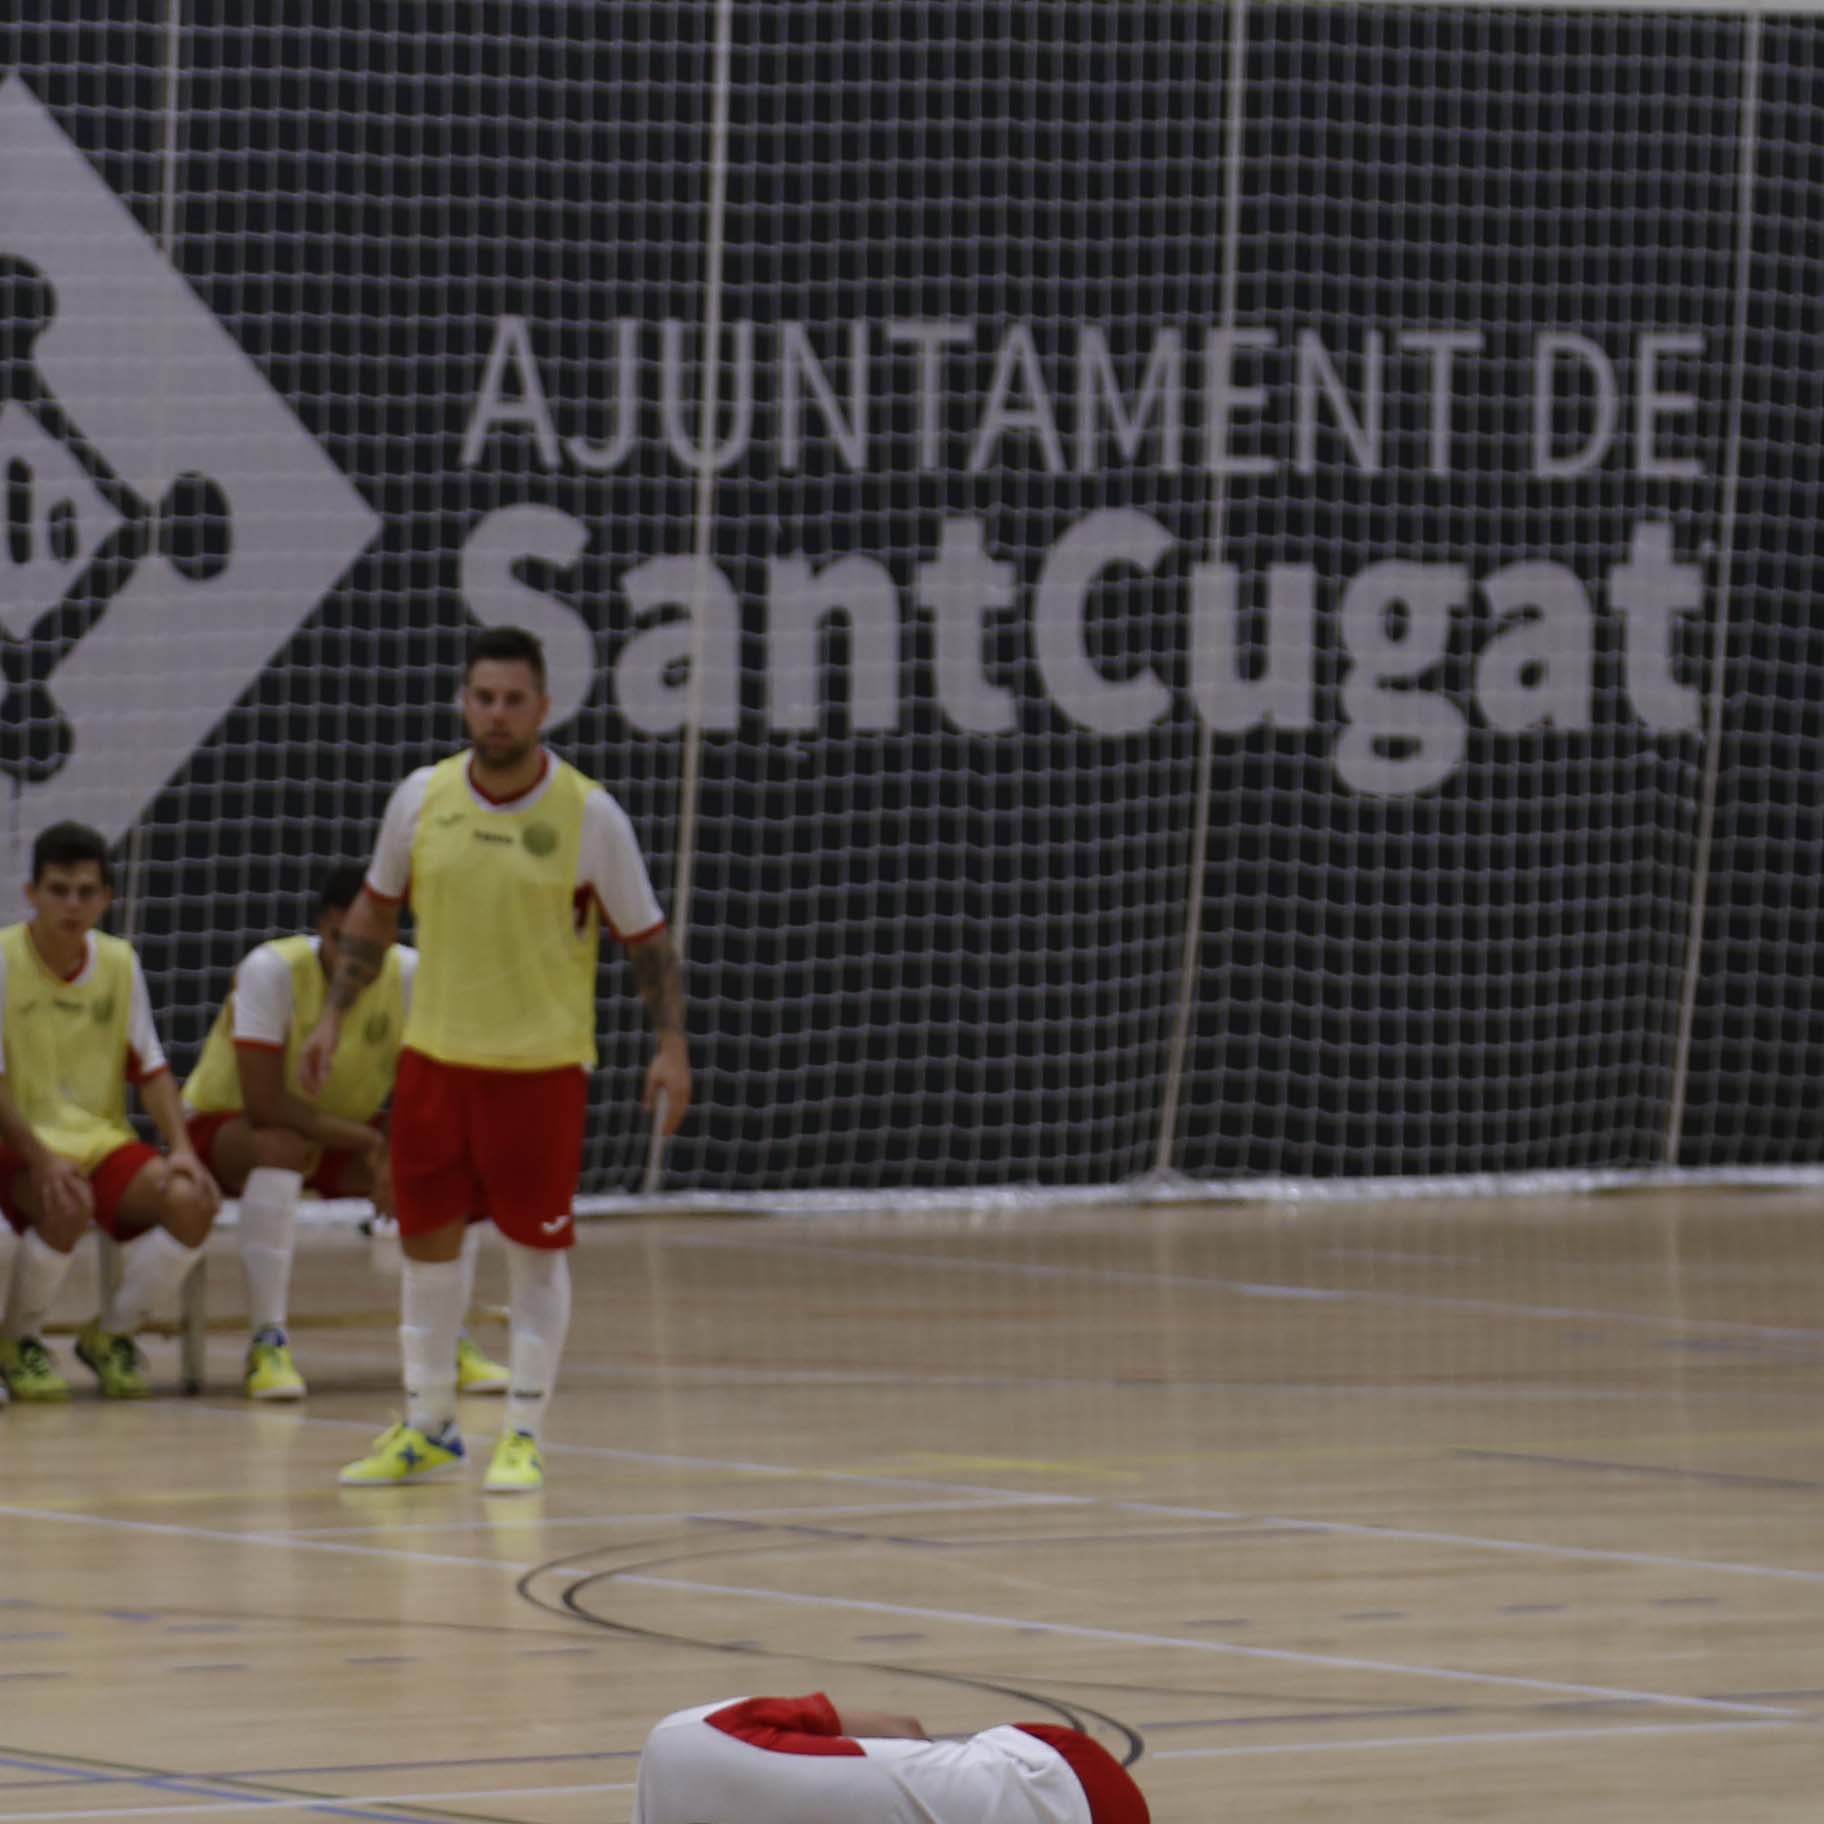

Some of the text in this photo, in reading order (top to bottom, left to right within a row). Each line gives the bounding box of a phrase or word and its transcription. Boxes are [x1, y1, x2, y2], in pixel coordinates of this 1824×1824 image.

[460, 314, 1709, 480] AJUNTAMENT DE
[460, 503, 1706, 796] SantCugat
